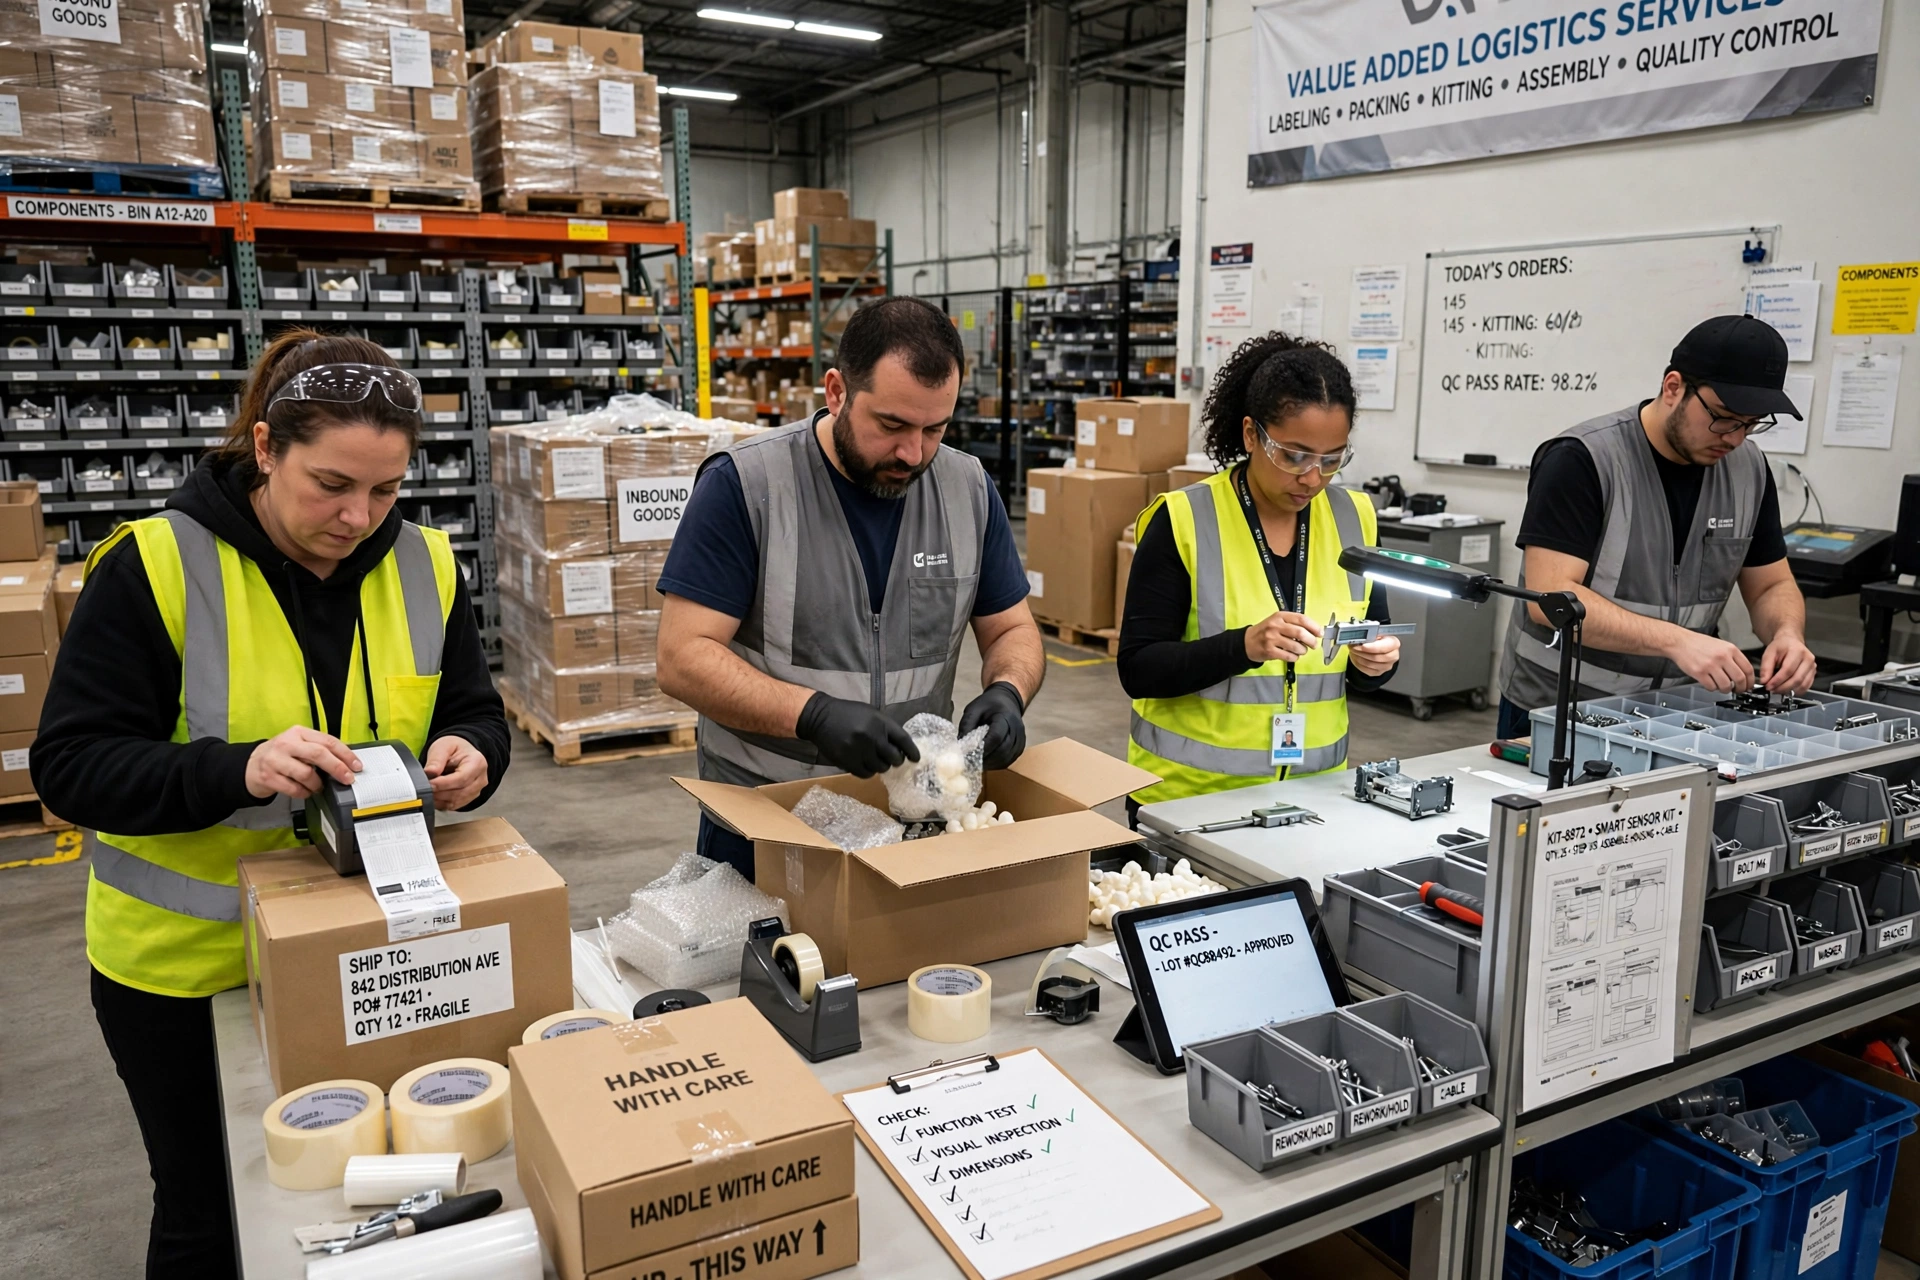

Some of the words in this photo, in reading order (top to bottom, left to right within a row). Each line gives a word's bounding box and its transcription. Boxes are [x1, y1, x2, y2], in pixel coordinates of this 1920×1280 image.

[52, 8, 108, 28] GOODS
[1287, 60, 1357, 98] VALUE
[1362, 41, 1449, 85] ADDED
[1457, 8, 1607, 67] LOGISTICS
[1615, 0, 1786, 36] SERVIC
[1268, 107, 1331, 134] LABELING
[1349, 92, 1410, 121] PACKING
[1431, 76, 1493, 107] KITTING
[1516, 55, 1611, 93] ASSEMBLY
[1636, 33, 1725, 73] QUALITY
[1730, 12, 1839, 54] CONTROL
[15, 200, 115, 218] COMPONENTS
[127, 205, 151, 219] BIN
[155, 207, 208, 221] A12-A20
[1444, 261, 1503, 283] TODAY'S
[1508, 256, 1573, 278] ORDERS:
[1841, 267, 1919, 282] COMPONENTS
[1443, 293, 1467, 310] 145
[1443, 316, 1465, 333] 145
[1482, 314, 1539, 332] KITTING:
[1476, 342, 1534, 360] KITTING:
[1441, 375, 1461, 394] QC
[1466, 374, 1499, 390] PASS
[1504, 374, 1545, 391] RATE:
[1551, 372, 1598, 392] 98.2%
[626, 488, 688, 504] INBOUND
[633, 507, 681, 522] GOODS
[1595, 818, 1626, 836] SMART
[1627, 811, 1661, 830] SENSOR
[1662, 808, 1676, 822] KIT
[1149, 933, 1172, 953] QC
[1173, 925, 1210, 946] PASS
[1161, 958, 1182, 972] LOT
[1244, 934, 1294, 954] APPROVED
[349, 954, 383, 974] SHIP
[388, 949, 412, 967] TO:
[351, 976, 376, 995] 842
[379, 957, 472, 992] DISTRIBUTION
[475, 951, 500, 971] AVE
[353, 995, 381, 1016] PO#
[384, 988, 423, 1010] 77421
[355, 1016, 383, 1037] QTY
[387, 1013, 402, 1030] 12
[415, 998, 470, 1024] FRAGILE
[604, 1052, 726, 1092] HANDLE
[613, 1086, 682, 1114] WITH
[685, 1070, 754, 1097] CARE
[877, 1106, 931, 1127] CHECK:
[915, 1113, 985, 1140] FUNCTION
[985, 1104, 1019, 1122] TEST
[1353, 1098, 1409, 1126] REWORK/HOLD
[930, 1139, 983, 1160] VISUAL
[984, 1117, 1062, 1146] INSPECTION
[1275, 1122, 1333, 1152] REWORK/HOLD
[948, 1149, 1033, 1181] DIMENSIONS
[630, 1186, 712, 1229] HANDLE
[717, 1171, 766, 1203] WITH
[771, 1156, 821, 1187] CARE
[690, 1246, 746, 1280] THIS
[753, 1228, 804, 1265] WAY
